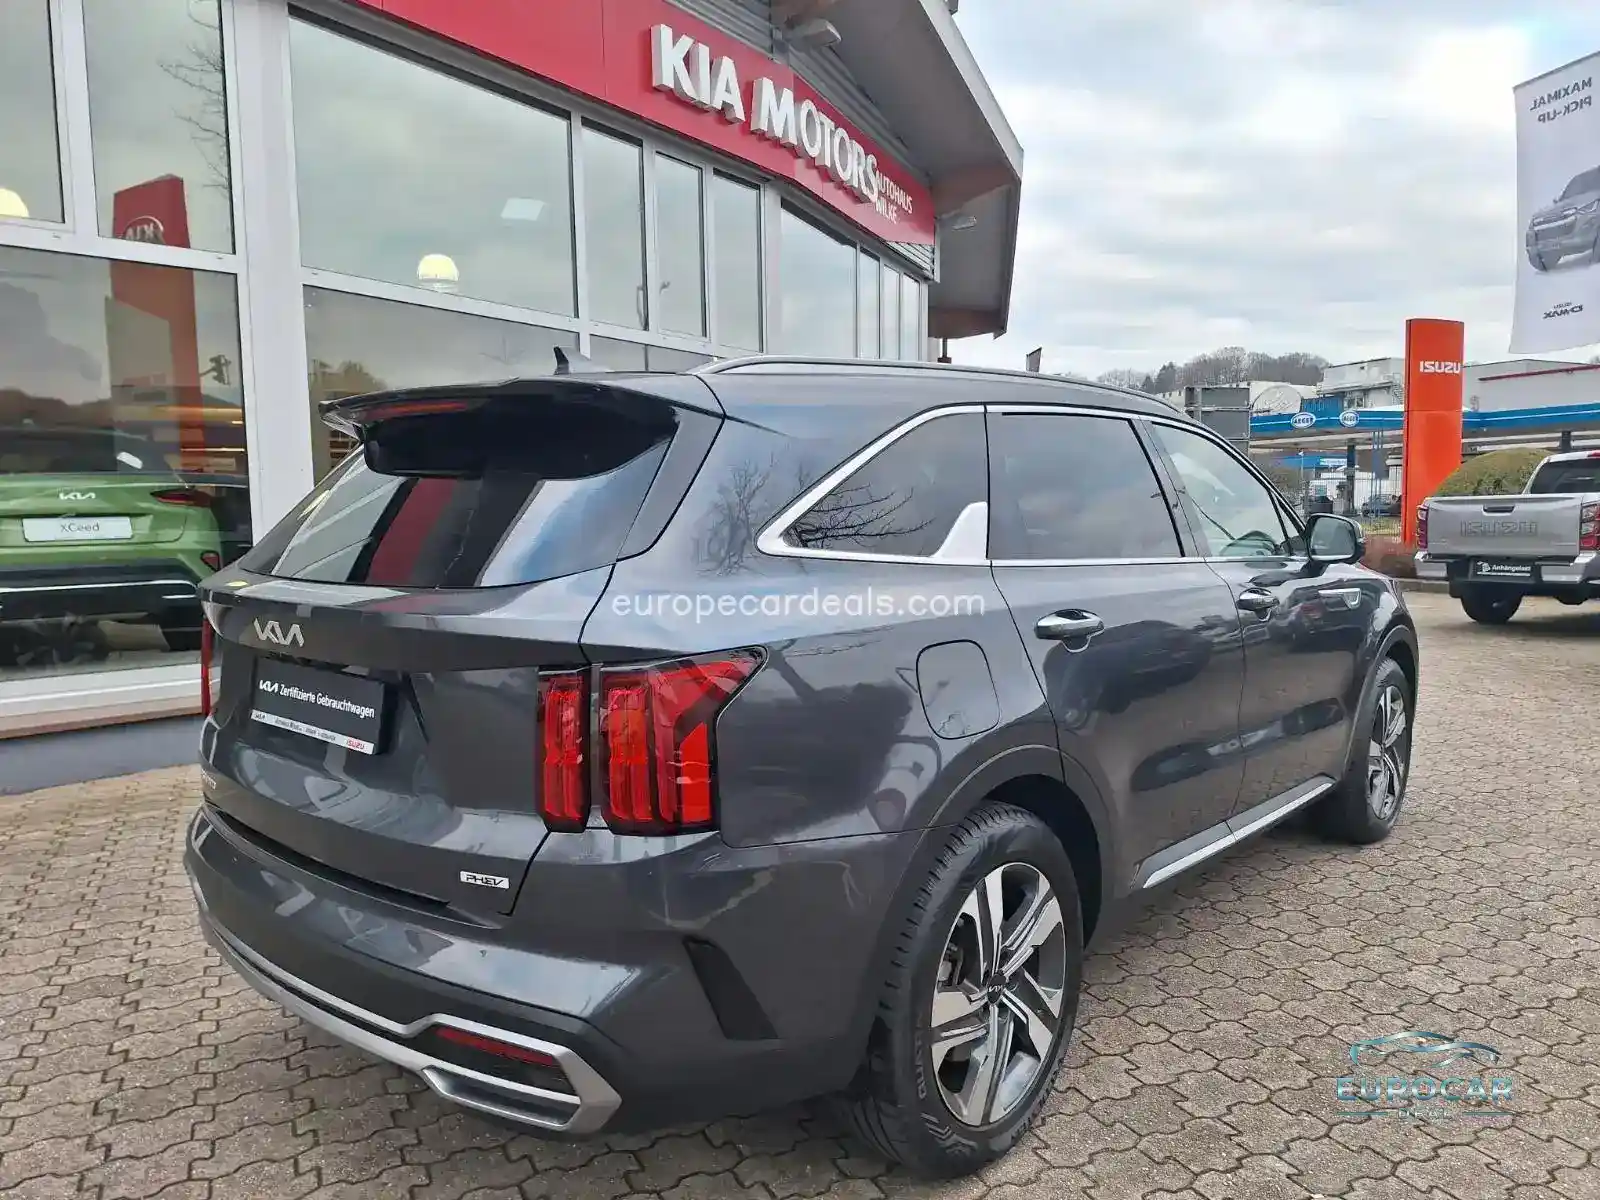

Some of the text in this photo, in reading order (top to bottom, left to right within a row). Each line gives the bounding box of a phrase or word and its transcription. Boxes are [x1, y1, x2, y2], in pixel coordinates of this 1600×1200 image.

[651, 24, 879, 203] KIA MOTORS
[876, 170, 912, 214] AUTOHAUS
[1419, 360, 1461, 374] ISUZU
[1460, 520, 1538, 537] ISUZU
[253, 617, 305, 648] KIA
[280, 684, 316, 703] Zertifizierte
[317, 693, 375, 719] Gebrauchtwagen
[466, 874, 504, 886] PHEV
